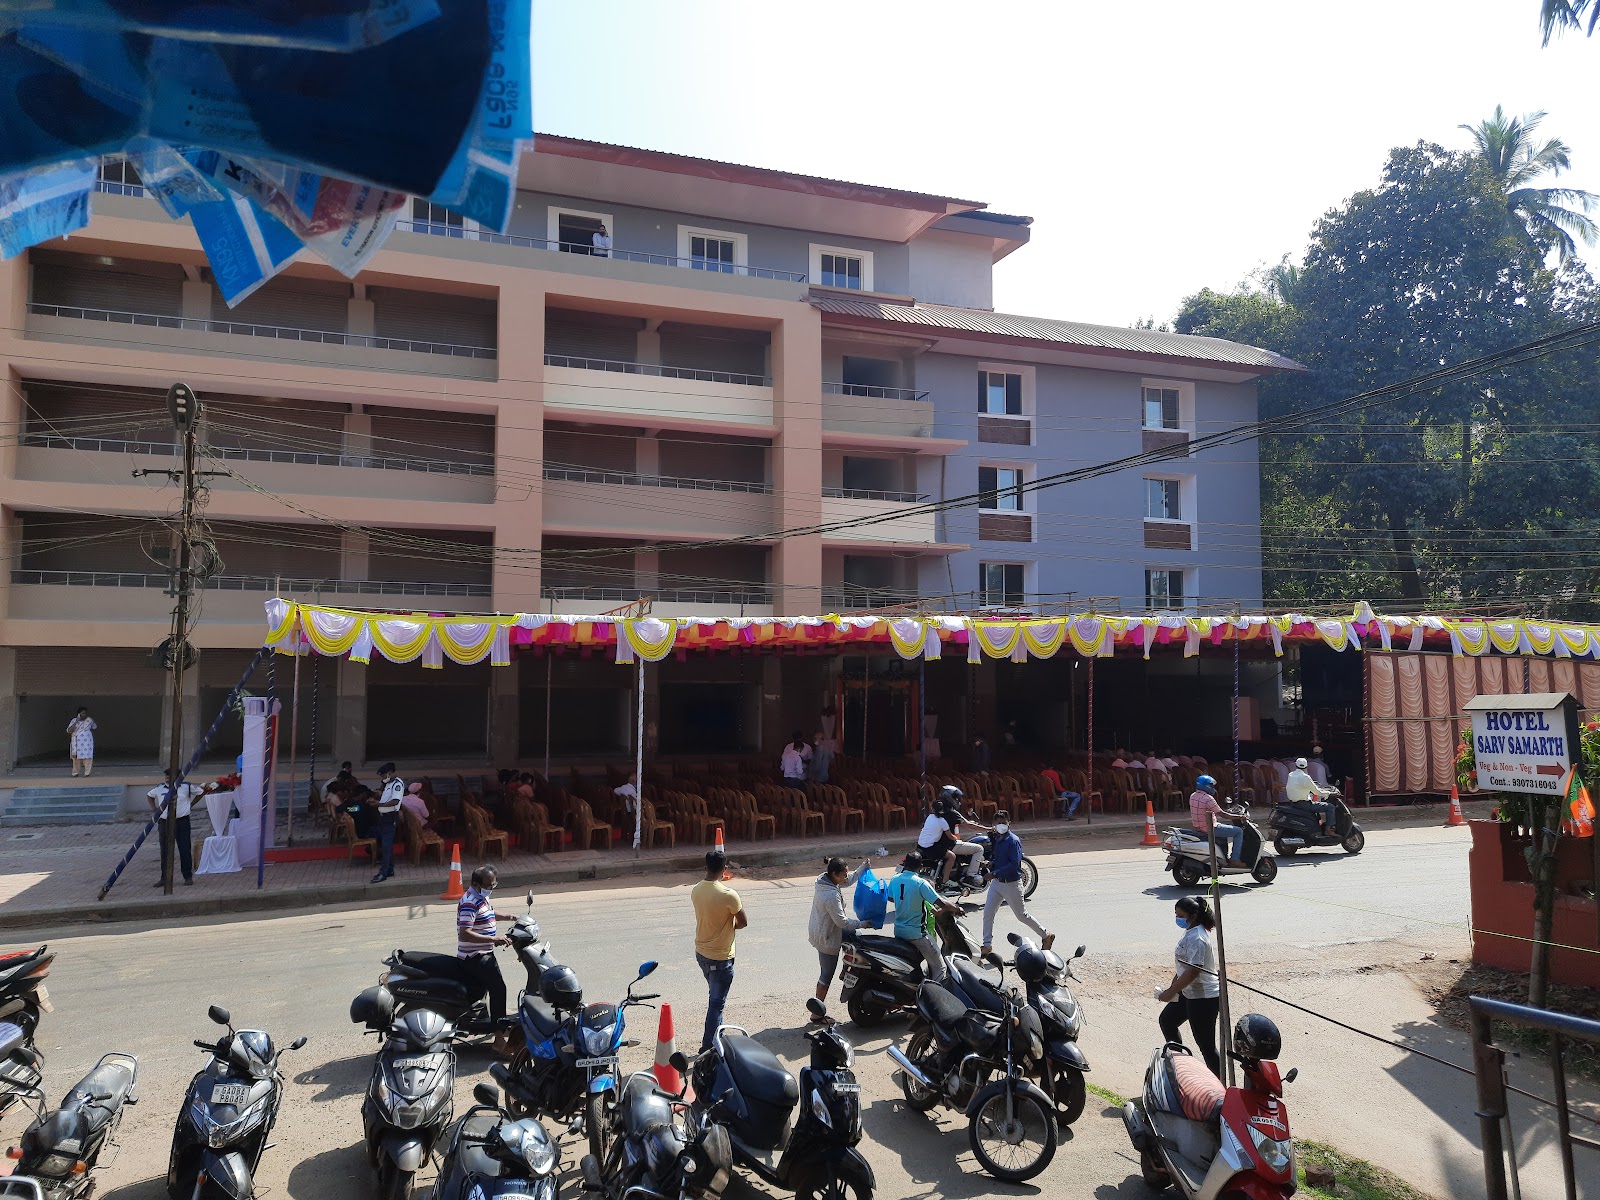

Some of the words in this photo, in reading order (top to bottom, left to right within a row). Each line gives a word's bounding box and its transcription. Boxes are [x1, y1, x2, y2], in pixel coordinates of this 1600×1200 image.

[212, 236, 241, 285] KN95
[1485, 711, 1550, 732] HOTEL
[1477, 735, 1506, 754] SARV
[1508, 736, 1564, 757] SAMARTH
[1479, 761, 1491, 772] Veg
[1492, 762, 1498, 770] &
[1499, 762, 1514, 772] Non
[1519, 763, 1533, 775] Veg
[1512, 778, 1557, 790] 9307316043
